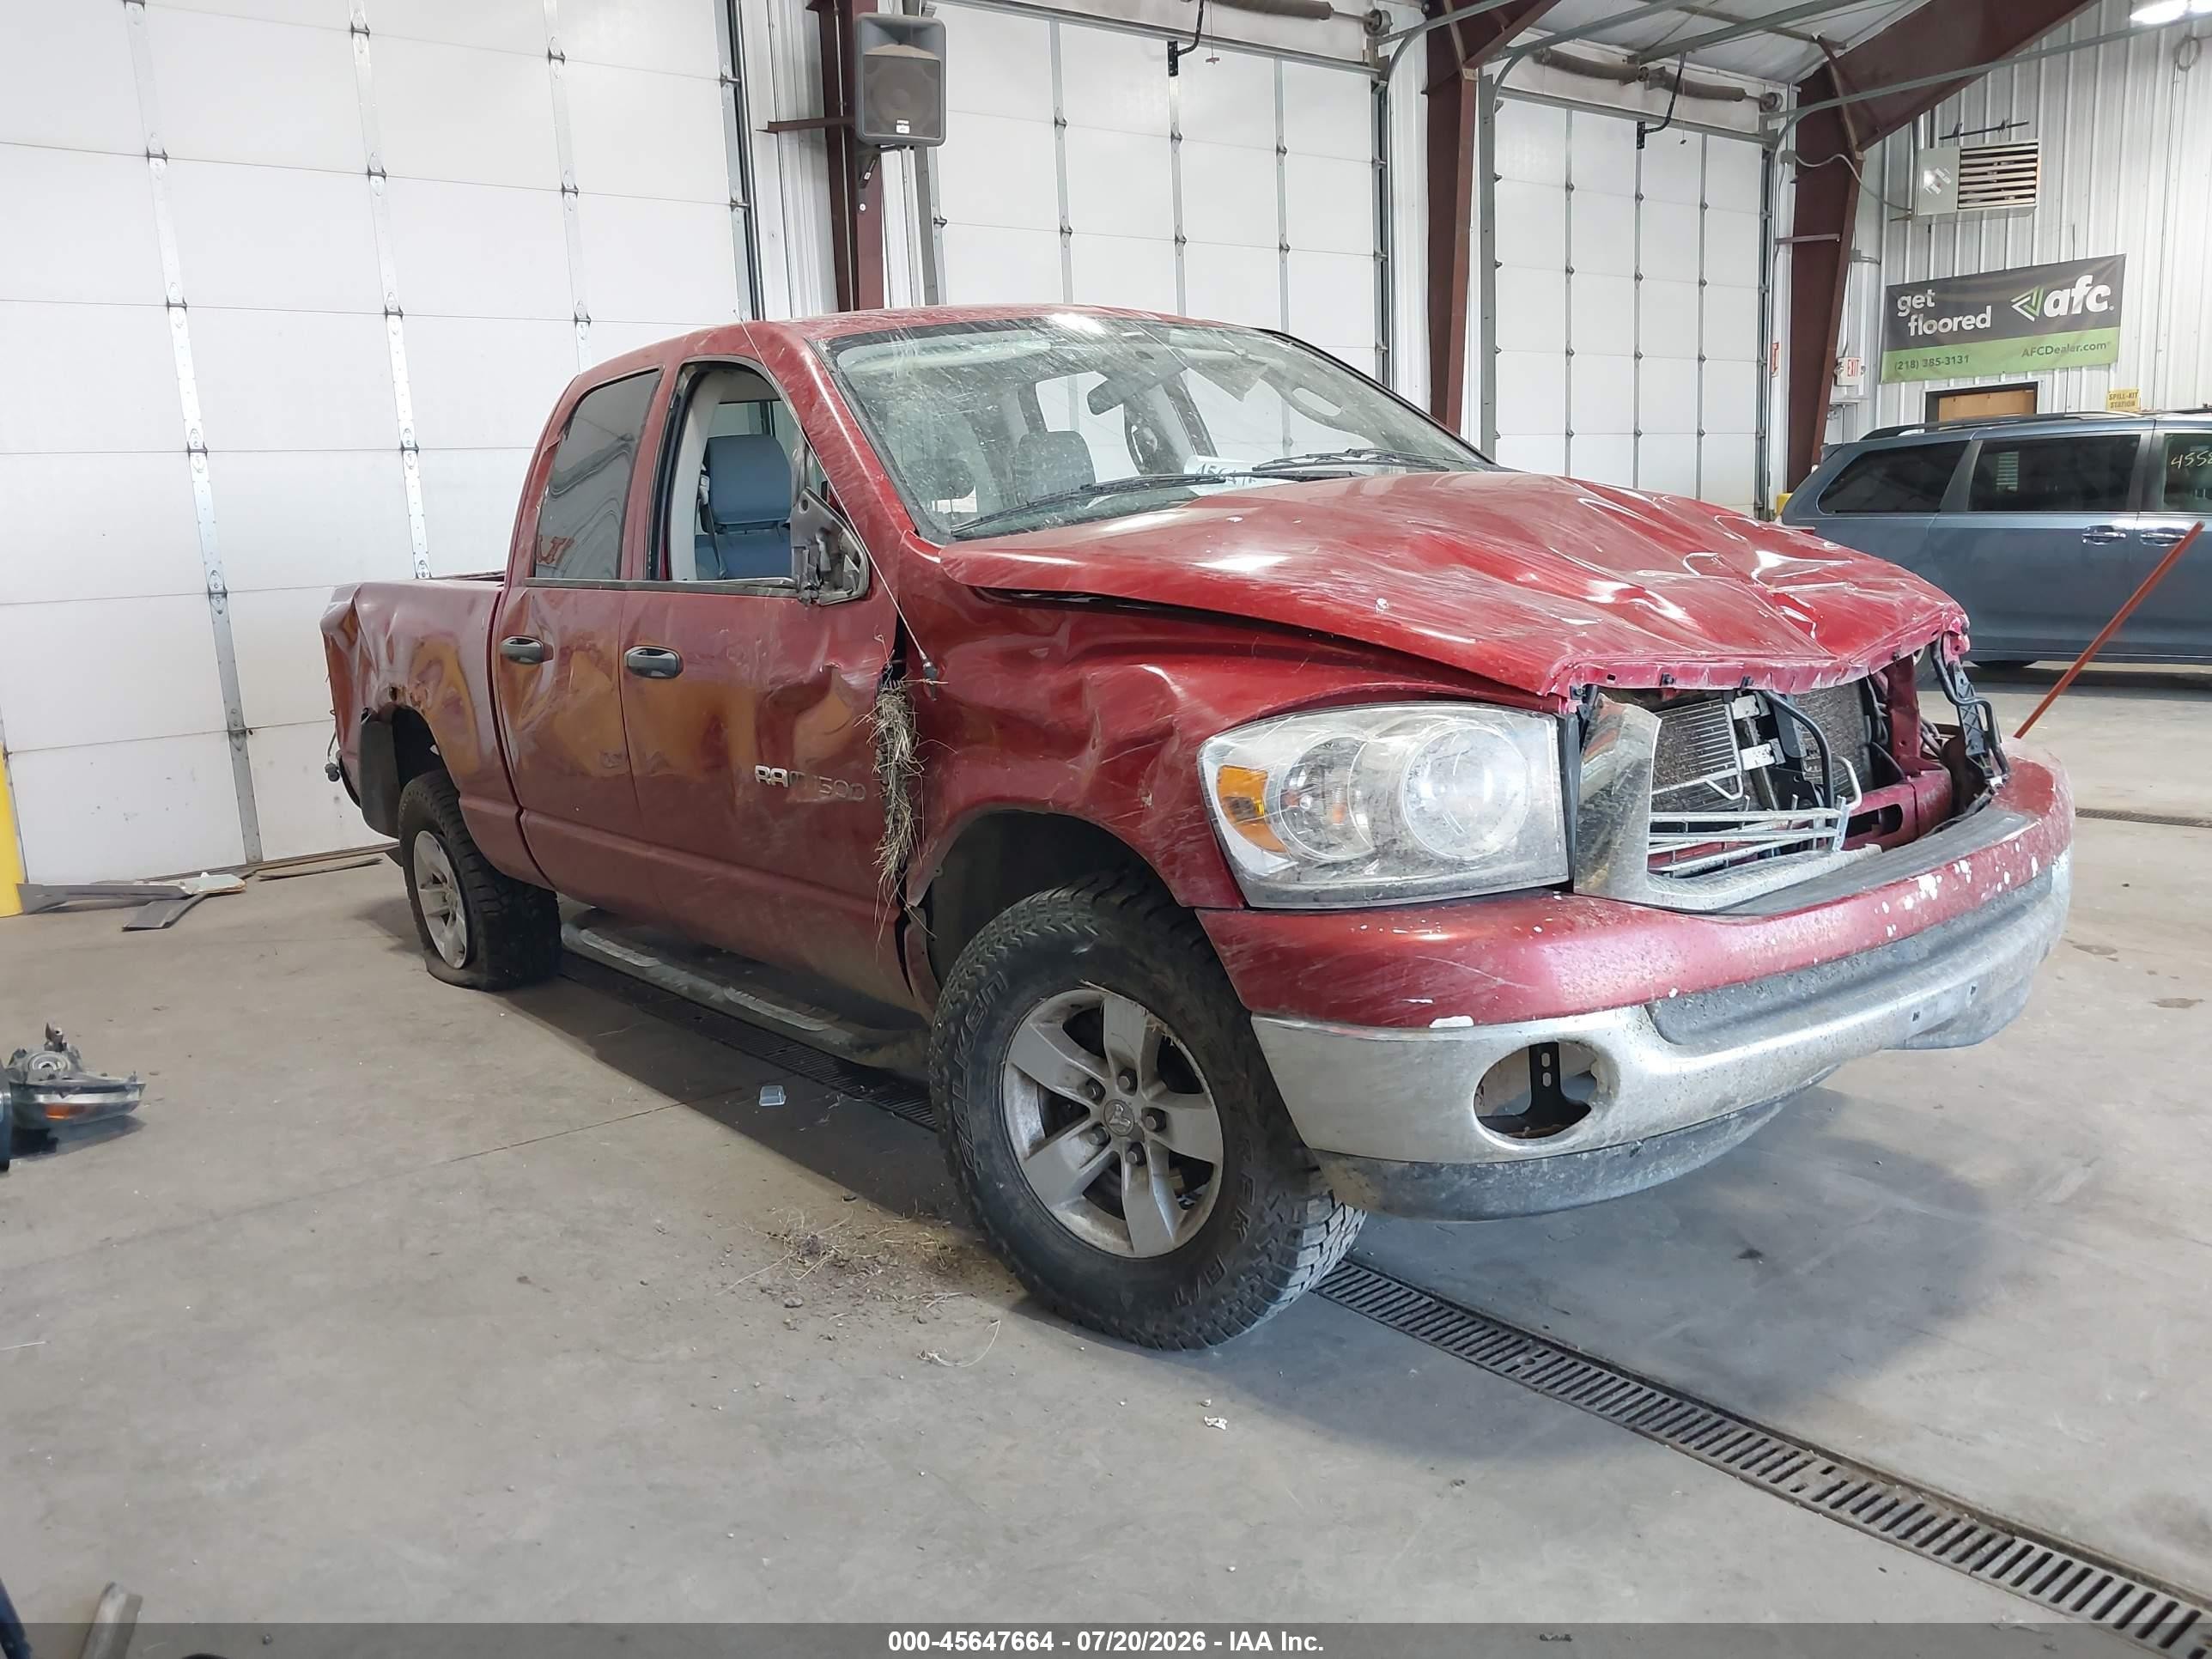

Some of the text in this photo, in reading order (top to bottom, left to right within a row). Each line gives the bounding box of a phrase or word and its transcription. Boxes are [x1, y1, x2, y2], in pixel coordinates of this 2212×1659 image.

[1897, 289, 1936, 317] get
[2043, 275, 2112, 318] afc
[1907, 305, 1992, 337] floored
[1894, 355, 1970, 372] (218) 385-3131
[2021, 342, 2107, 358] AFCDealer.com
